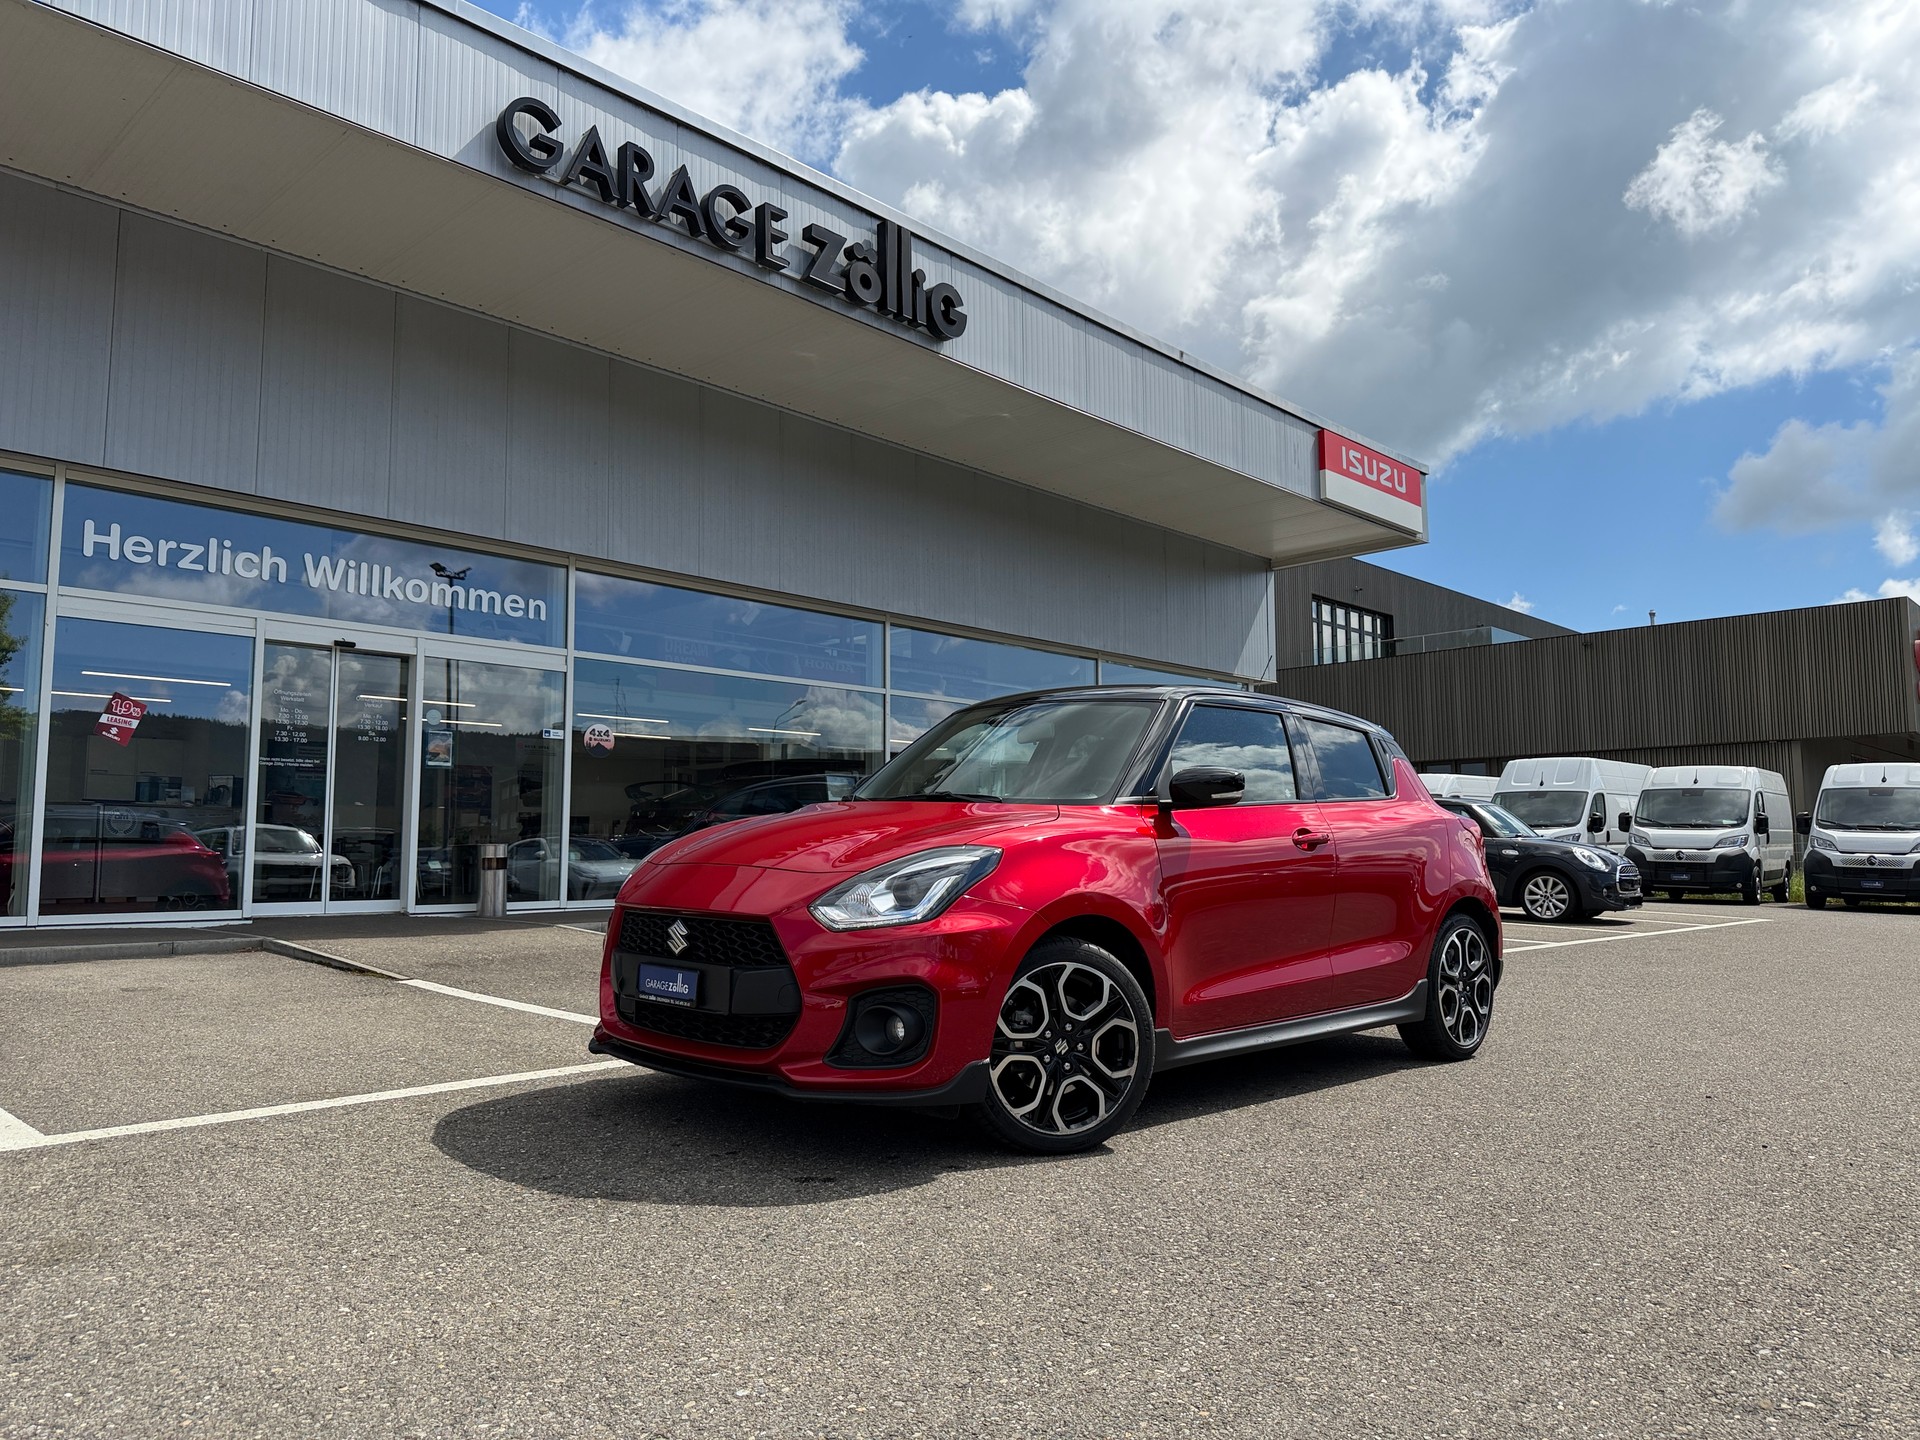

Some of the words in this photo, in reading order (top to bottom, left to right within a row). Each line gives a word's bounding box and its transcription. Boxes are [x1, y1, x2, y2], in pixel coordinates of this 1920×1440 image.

[496, 96, 790, 271] GARAGE
[1341, 446, 1407, 494] ISUZU
[82, 519, 288, 583] Herzlich
[303, 552, 547, 621] Willkommen
[664, 639, 709, 658] DREAM
[804, 656, 855, 673] HONDA
[106, 716, 133, 726] LEASING
[589, 728, 610, 738] 4x4
[645, 978, 669, 991] GARAGE
